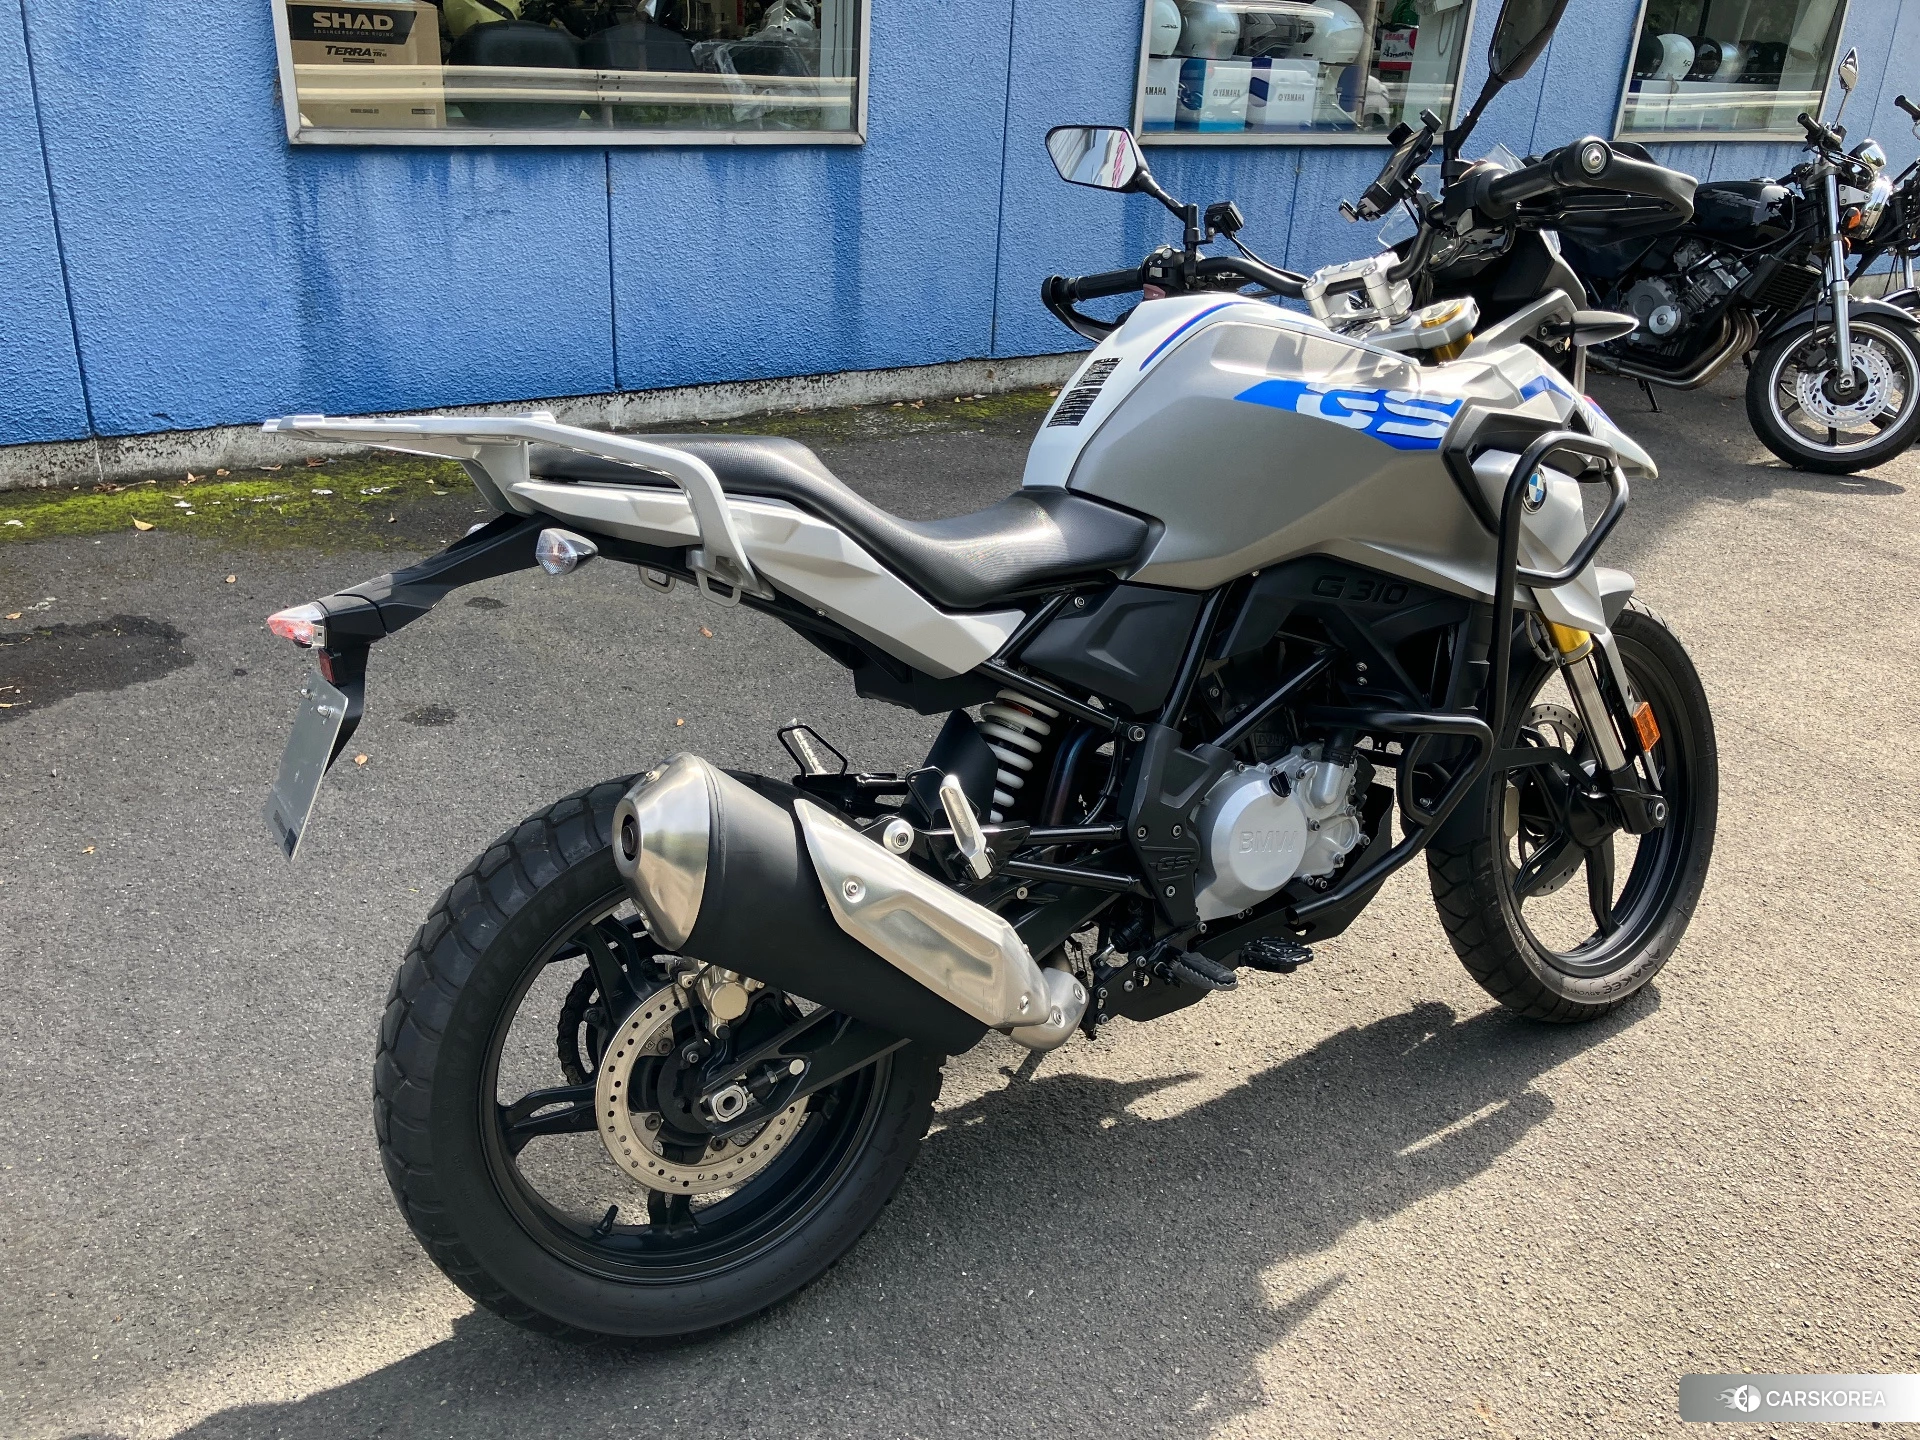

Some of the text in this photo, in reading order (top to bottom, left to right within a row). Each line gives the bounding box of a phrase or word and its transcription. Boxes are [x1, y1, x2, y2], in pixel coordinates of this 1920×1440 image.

[312, 11, 394, 31] SHAD
[325, 45, 371, 57] TERRA
[1145, 86, 1167, 96] AMAHA
[1219, 88, 1241, 98] YAMAHA
[1284, 93, 1305, 102] YAMAHA
[1295, 382, 1454, 439] GS
[1312, 574, 1410, 606] G 310
[1239, 830, 1299, 854] BMW
[1154, 855, 1193, 872] GS
[1602, 948, 1661, 995] ANAKEE
